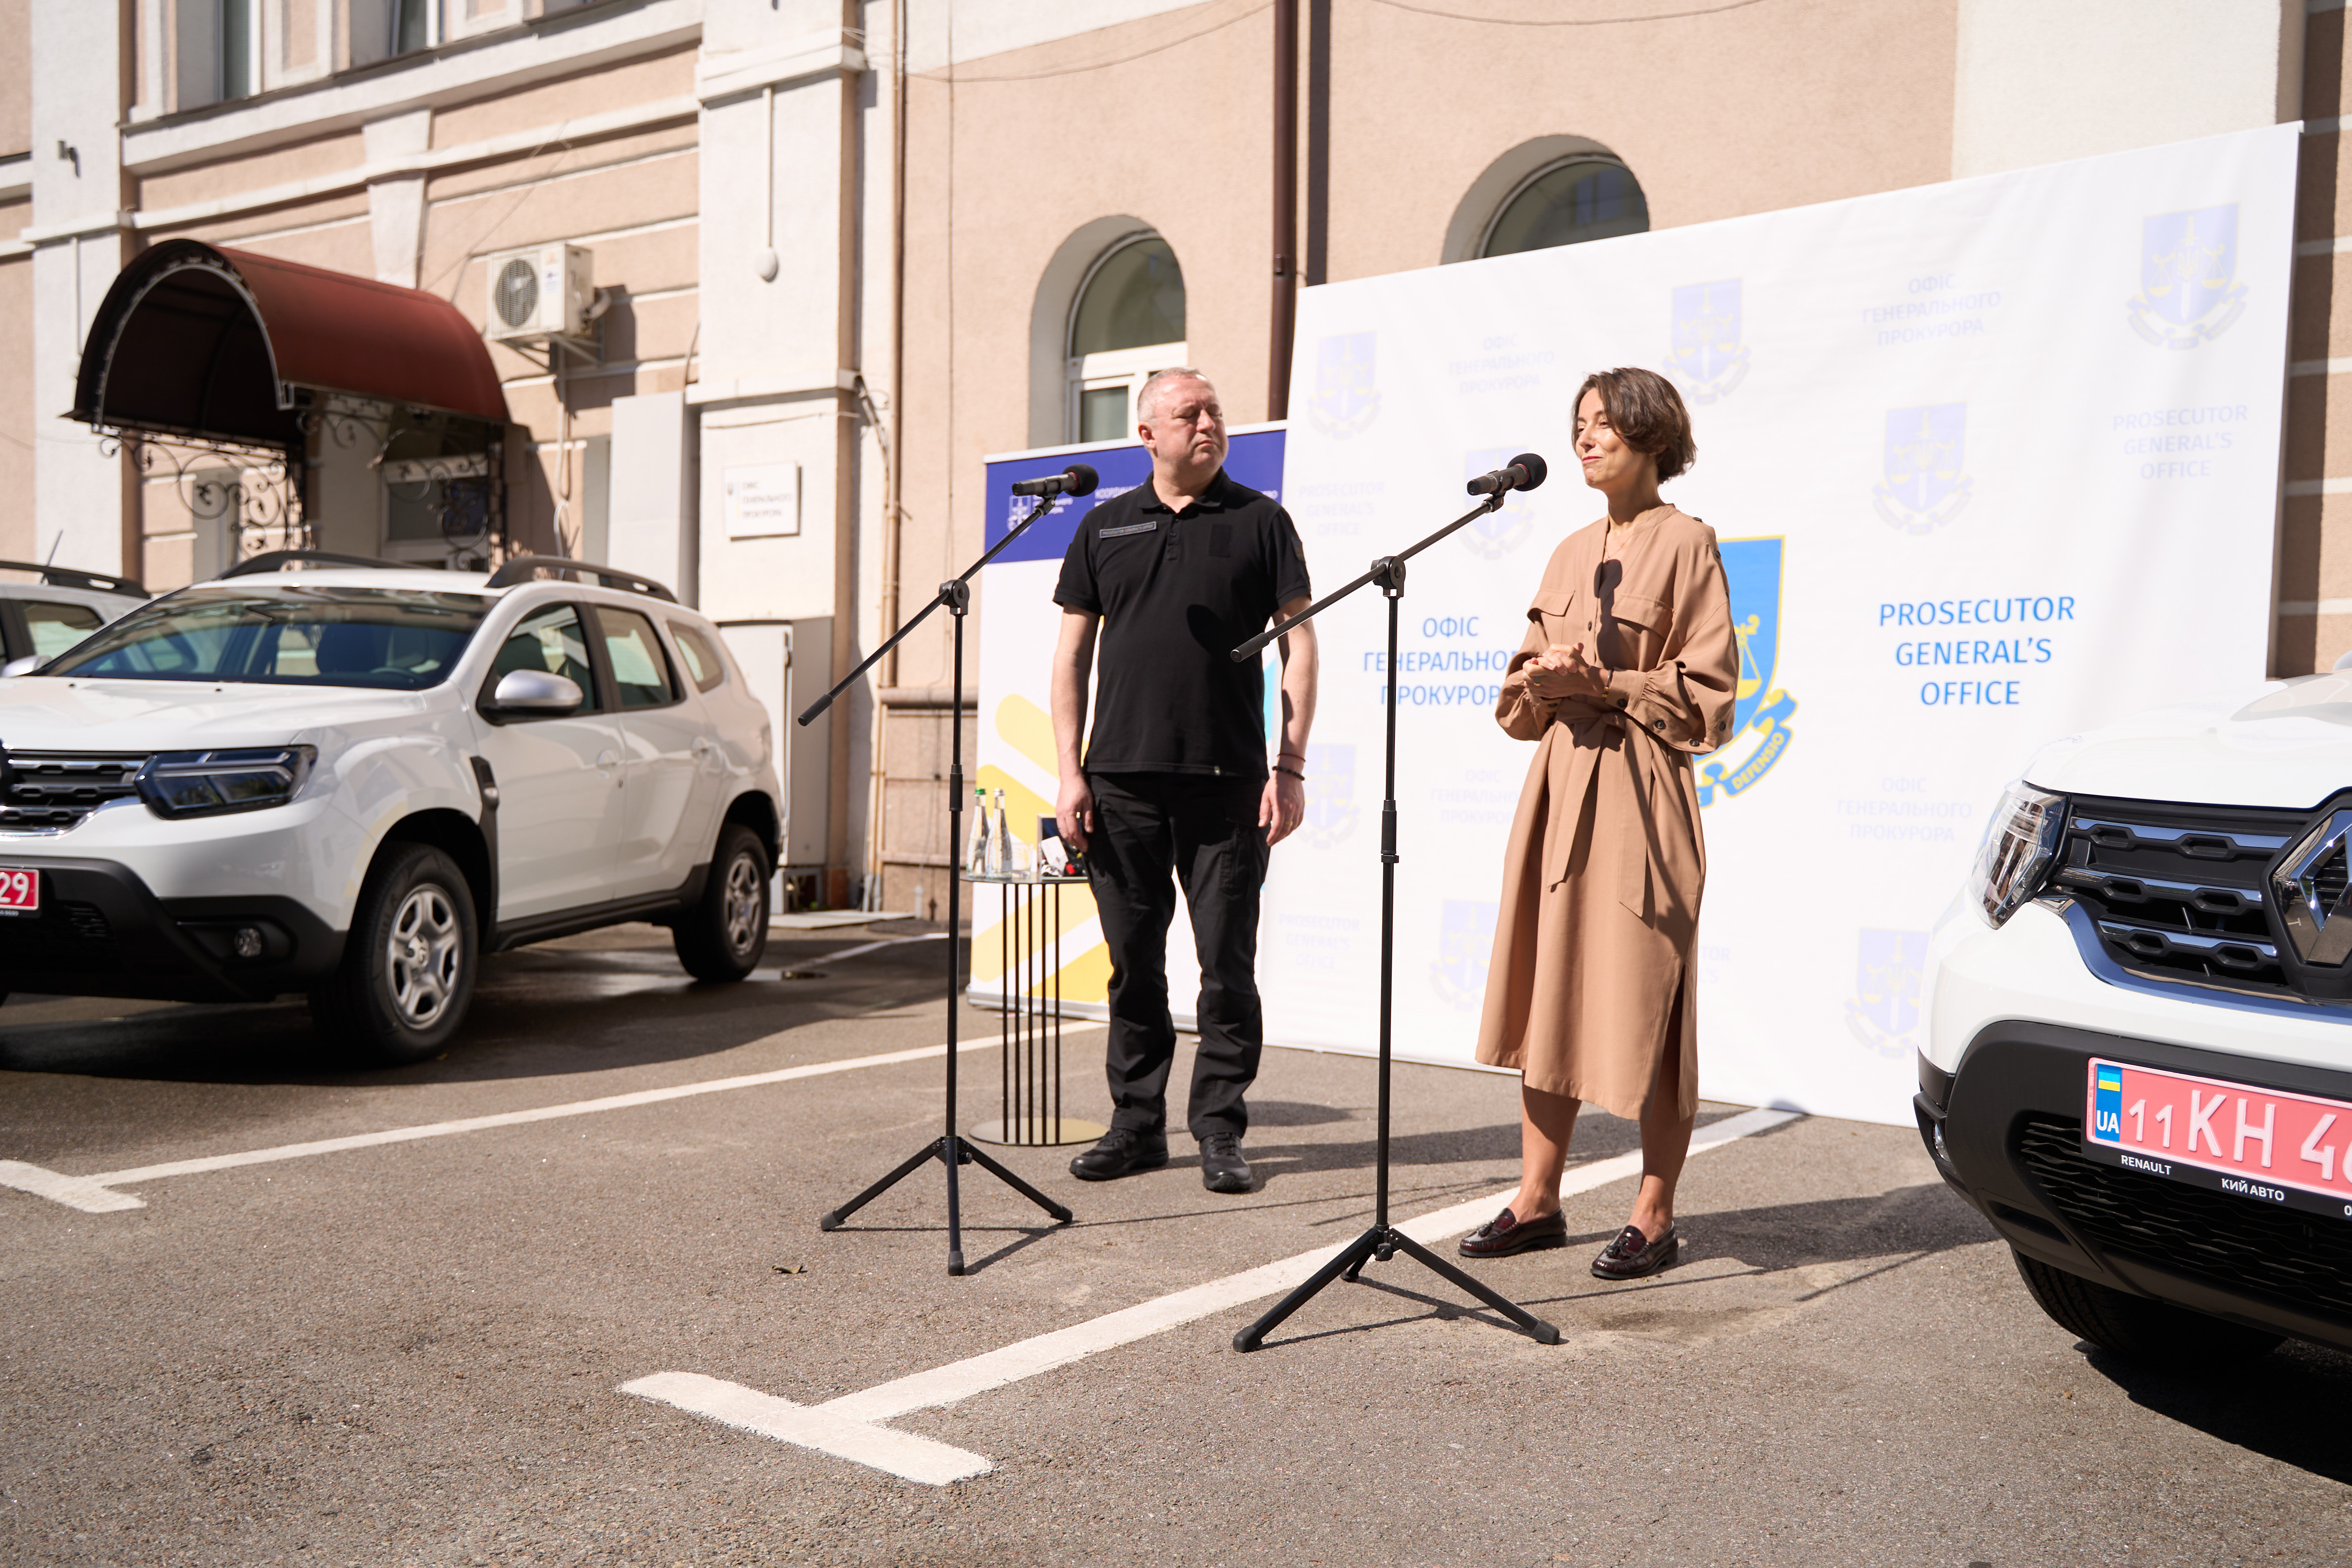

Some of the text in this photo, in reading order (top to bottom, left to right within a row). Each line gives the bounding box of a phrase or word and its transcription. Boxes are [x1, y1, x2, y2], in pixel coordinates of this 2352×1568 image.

[1908, 273, 1956, 294] ОФІС
[1862, 291, 2002, 324] ГЕНЕРАЛЬНОГО
[1877, 318, 1985, 347] ПРОКУРОРА
[2113, 404, 2249, 432] PROSECUTOR
[2123, 431, 2233, 456] GENERAL'S
[2140, 460, 2211, 480] OFFICE
[1880, 597, 2075, 626] PROSECUTOR
[1423, 616, 1479, 637] ОФІС
[1364, 651, 1518, 672] ГЕЕРАЛЬНО
[1896, 637, 2052, 666] GENERAL'S
[1921, 681, 2020, 705] OFFICE
[1732, 732, 1785, 790] DEFENSIO
[1431, 788, 1519, 804] ГЕНЕРАЛЬНО
[1881, 777, 1926, 793] ОФІС
[1441, 810, 1514, 825] ПРОКУРОР
[1837, 800, 1972, 818] ГЕНЕРАЛЬНОГО
[1850, 823, 1955, 842] ПРОКУРОРА
[2096, 1110, 2120, 1133] UA
[2121, 1155, 2171, 1175] RENAULT
[2221, 1178, 2285, 1201] КИЙ АВТО
